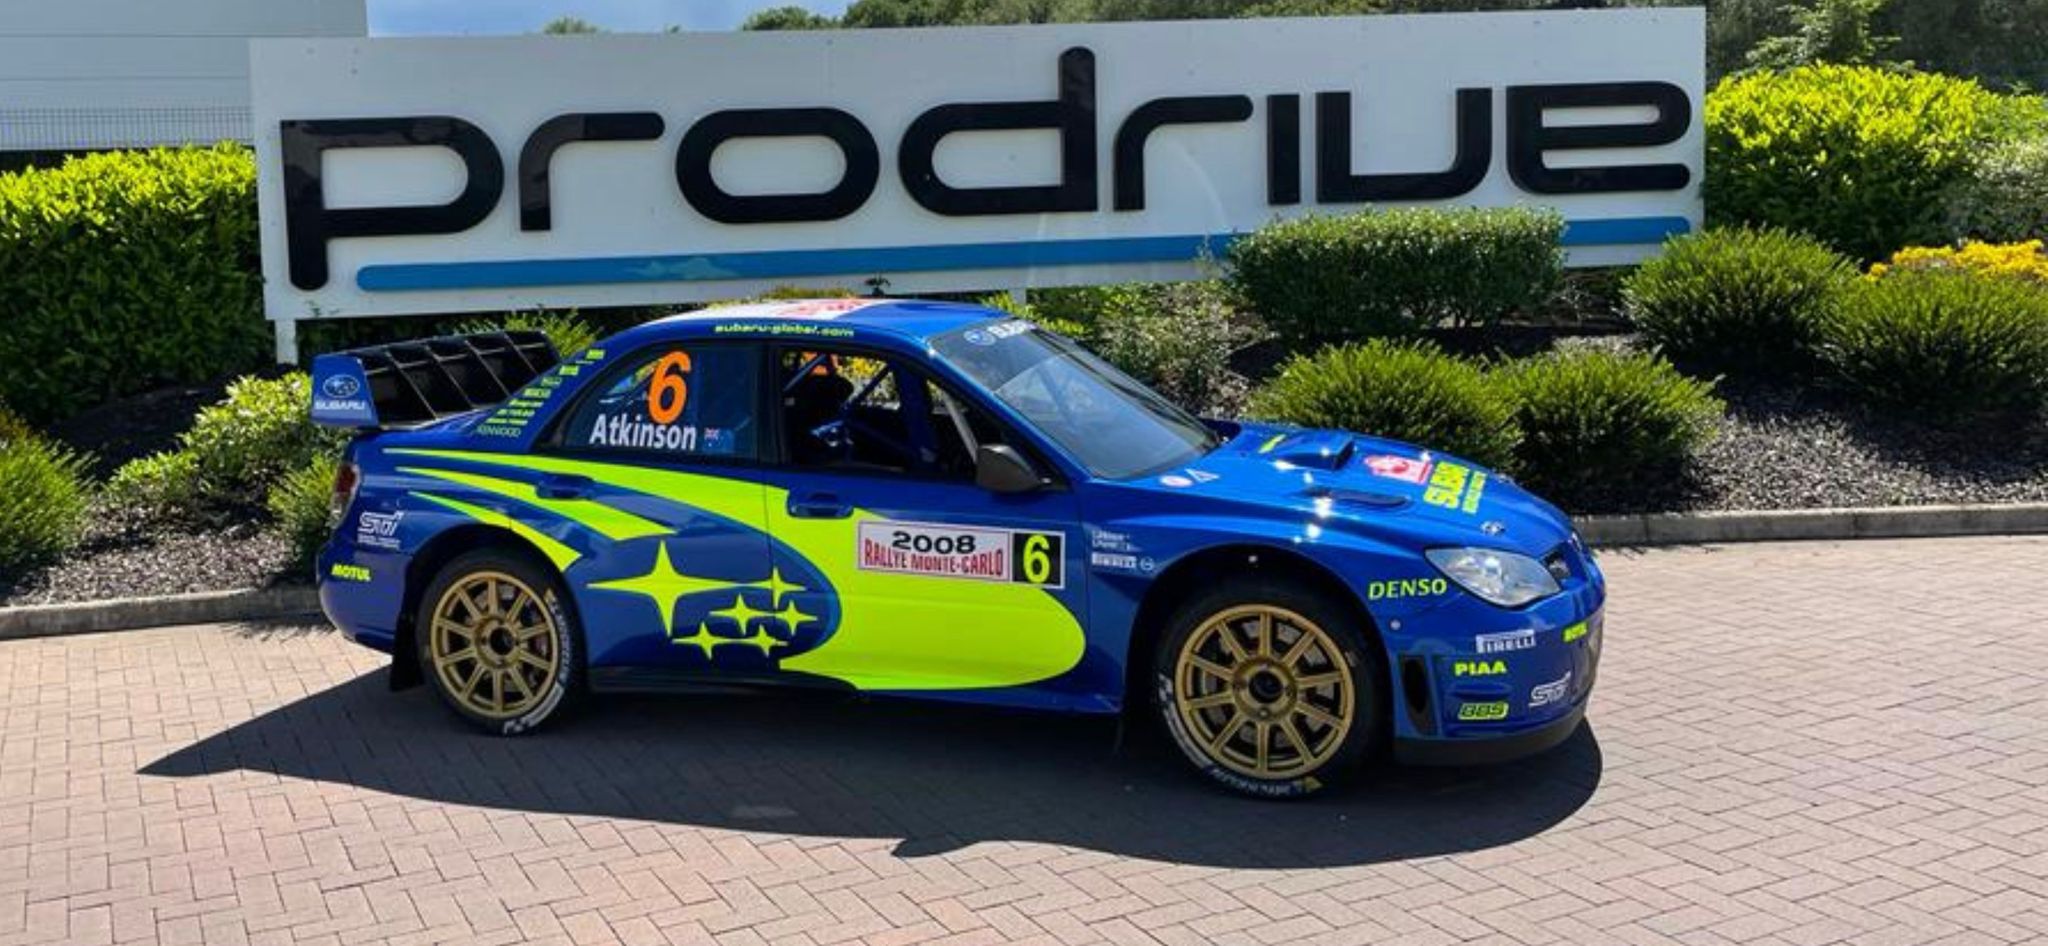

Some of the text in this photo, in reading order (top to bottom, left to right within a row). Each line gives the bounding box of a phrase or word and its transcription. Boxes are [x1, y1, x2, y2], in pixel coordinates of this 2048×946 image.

[281, 47, 1692, 291] prodrive
[715, 322, 855, 337] subaru-global.com
[648, 350, 691, 424] 6
[589, 412, 697, 451] Atkinson
[892, 531, 976, 554] 2008
[864, 538, 1003, 576] RALLYE MONTE-CARLO
[1023, 534, 1050, 584] 6
[331, 563, 371, 582] MOTUL
[1368, 578, 1447, 600] DENSO
[1476, 629, 1535, 653] PIRELLI
[1454, 661, 1508, 676] PIAA
[1461, 704, 1505, 717] BBS
